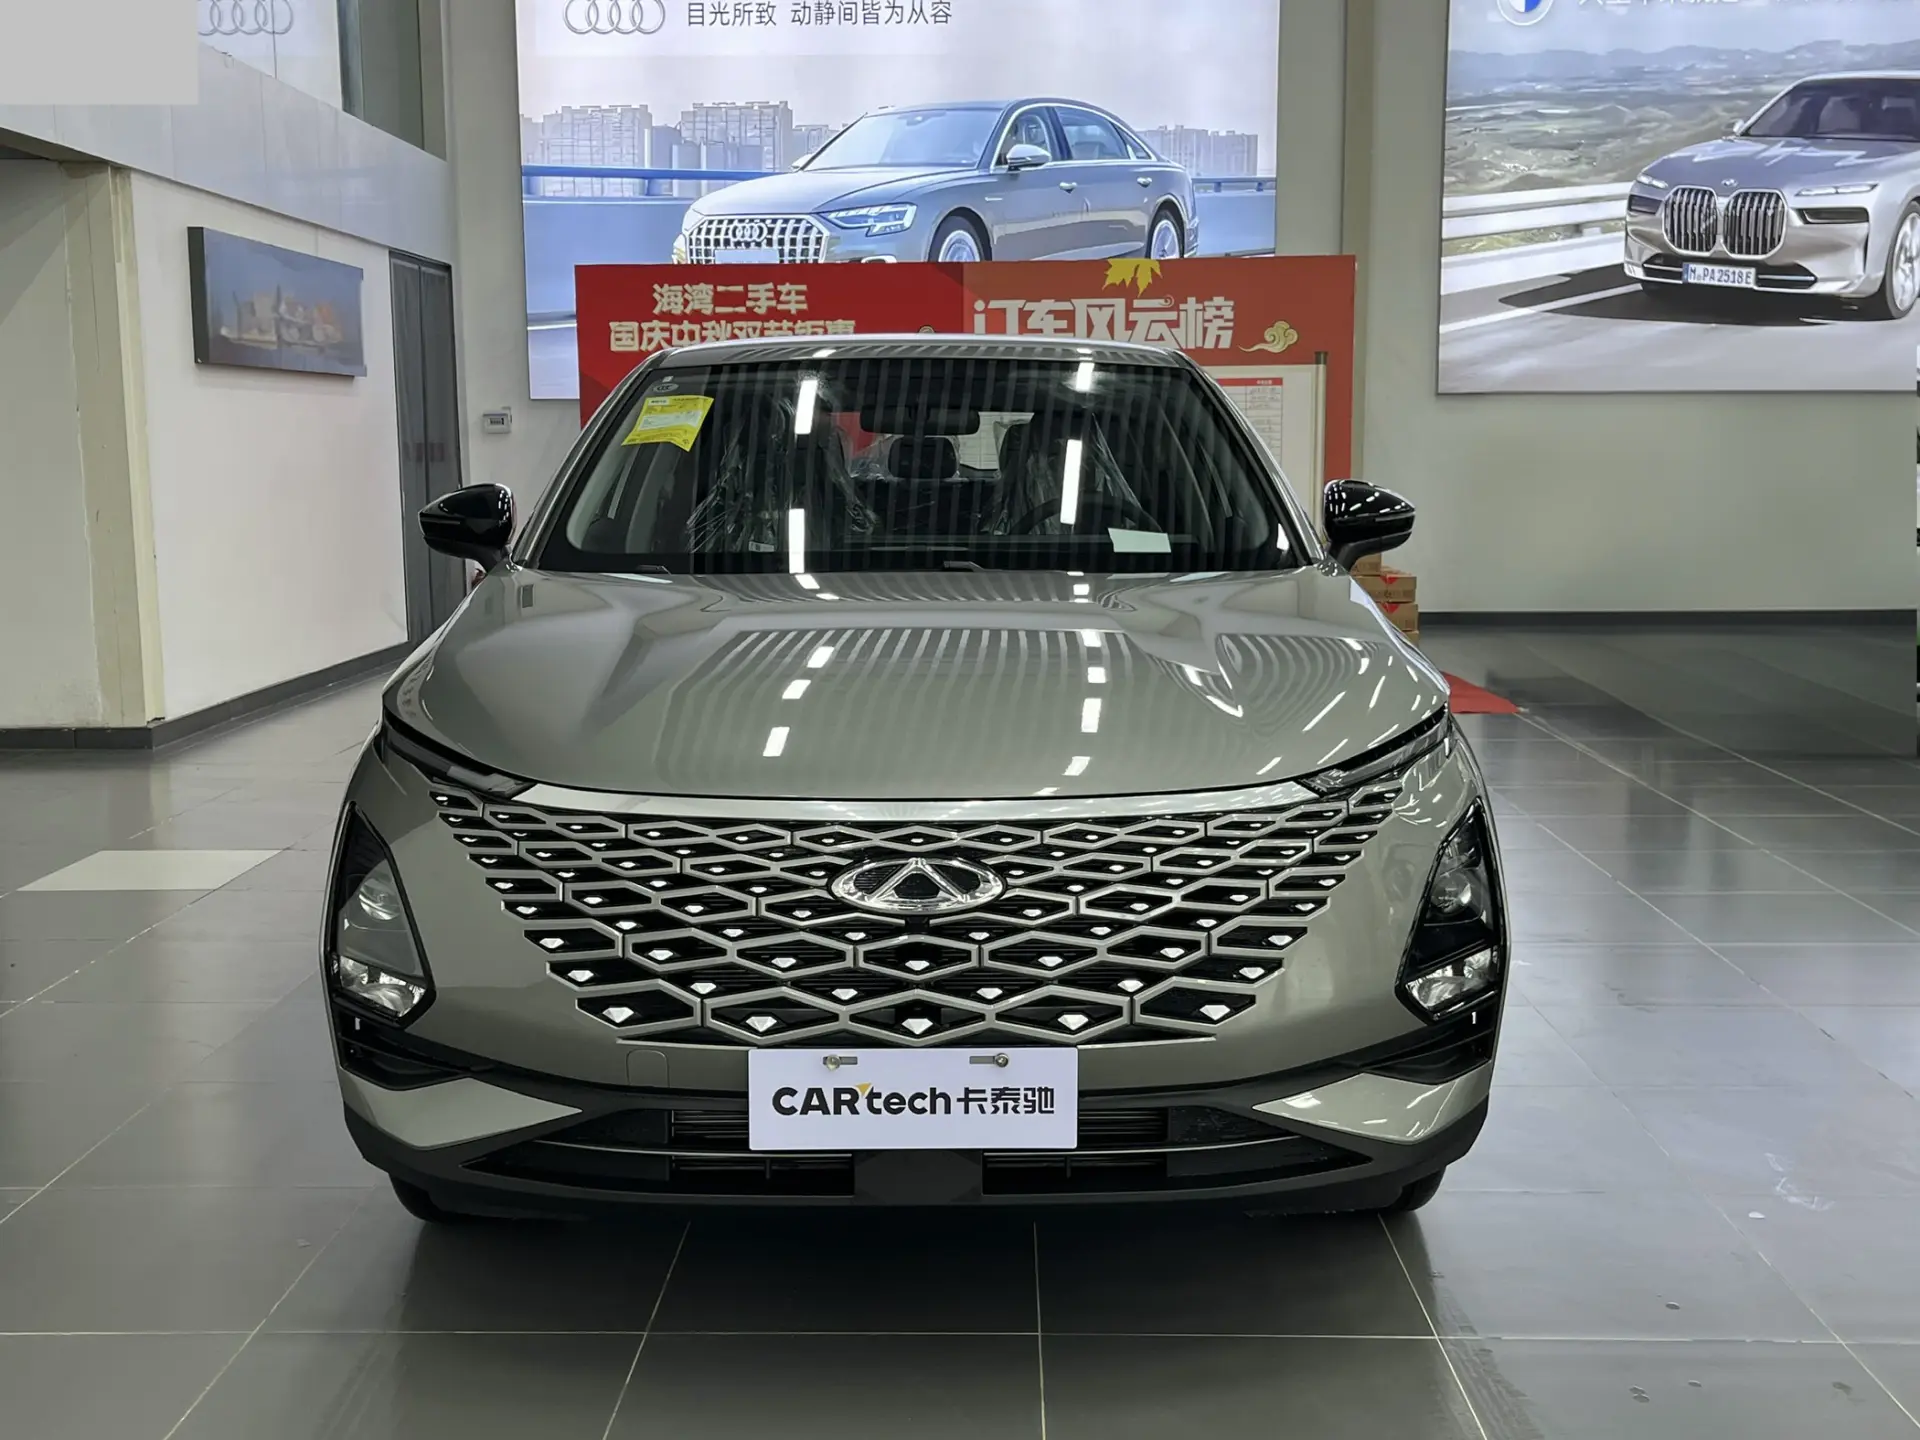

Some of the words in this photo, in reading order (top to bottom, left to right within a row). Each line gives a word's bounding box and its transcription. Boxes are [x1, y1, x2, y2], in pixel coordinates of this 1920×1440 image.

[687, 2, 777, 27] 目光所致
[790, 0, 953, 26] 动静间皆为从容
[652, 282, 808, 315] 海湾二手车
[973, 294, 1235, 350] 订车风云榜
[771, 1086, 952, 1117] CARtech
[956, 1086, 1055, 1116] 卡泰驰
